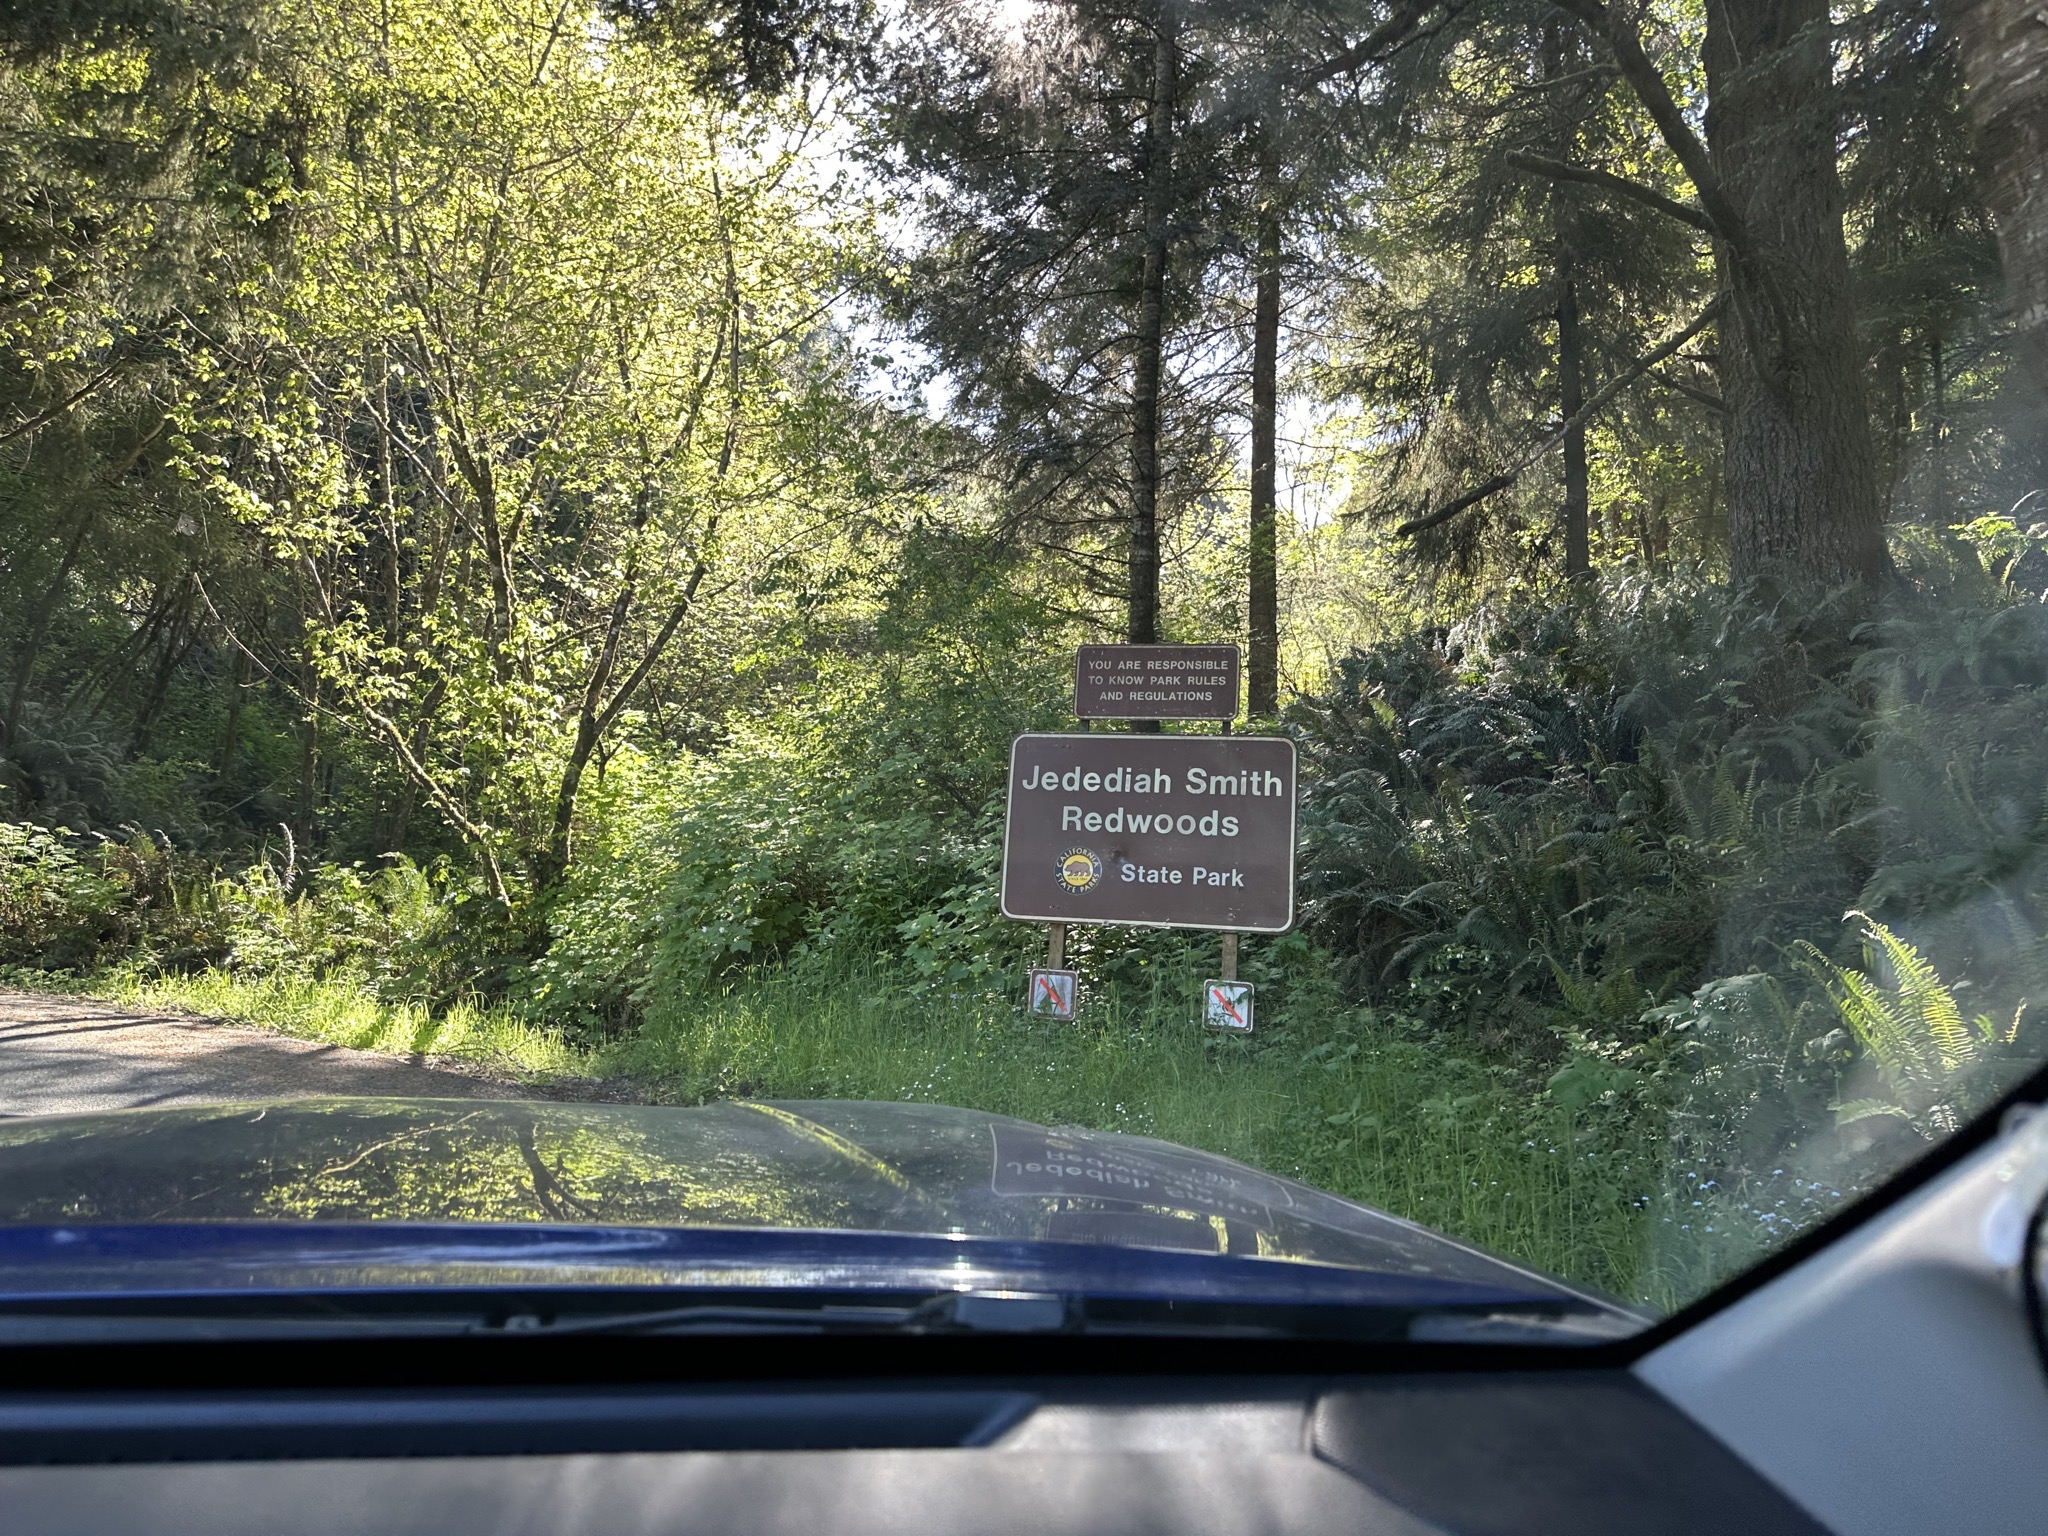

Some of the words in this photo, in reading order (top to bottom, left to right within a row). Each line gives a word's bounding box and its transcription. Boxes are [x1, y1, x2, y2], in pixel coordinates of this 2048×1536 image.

[1088, 660, 1112, 670] YOU
[1117, 660, 1141, 670] ARE
[1146, 660, 1229, 670] RESPONSIBLE
[1088, 675, 1104, 685] TO
[1108, 675, 1145, 686] KNOW
[1150, 676, 1181, 686] PARK
[1187, 676, 1227, 686] RULES
[1099, 691, 1123, 701] AND
[1129, 691, 1213, 701] REGULATIONS
[1022, 764, 1172, 794] Jedediah
[1185, 767, 1283, 797] Smith
[1061, 805, 1240, 837] Redwoods
[1056, 847, 1100, 868] CALIFORNIA
[1055, 872, 1077, 894] STATE
[1079, 873, 1100, 893] PARKS
[1120, 863, 1183, 885] State
[1192, 866, 1245, 888] Park
